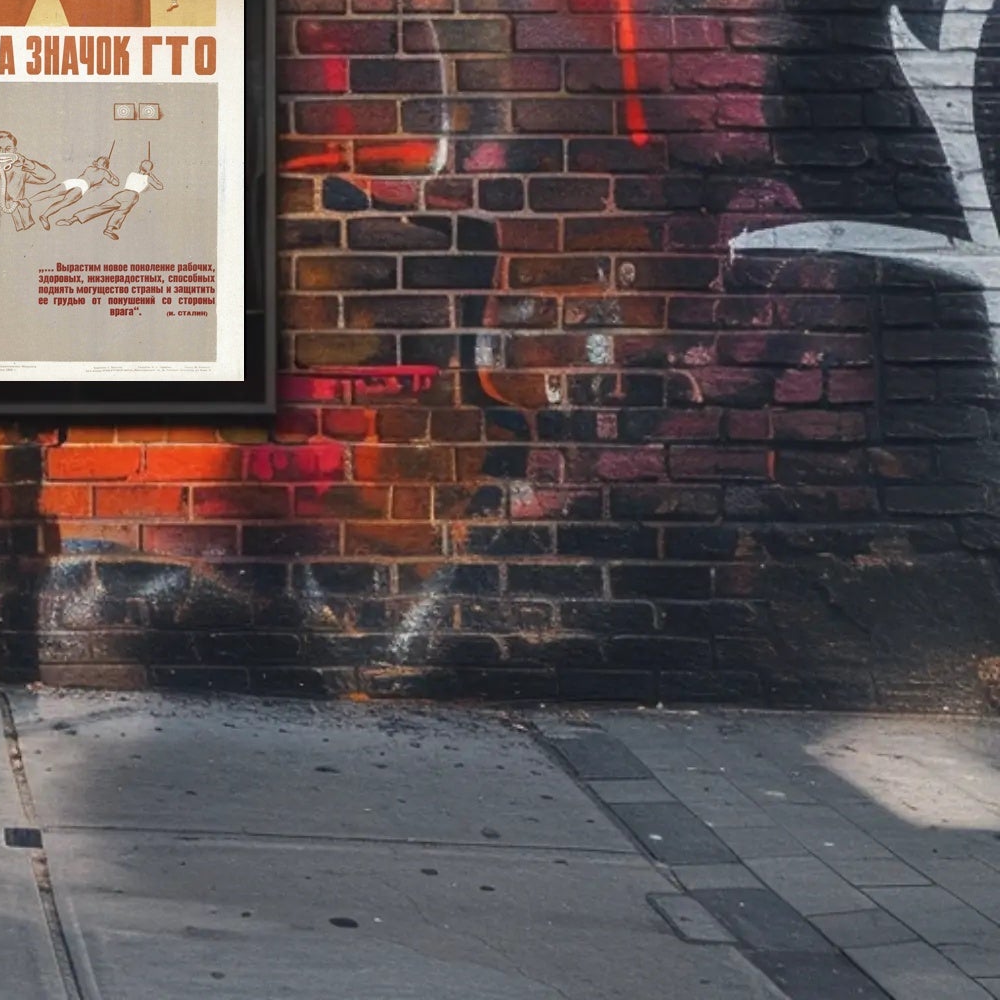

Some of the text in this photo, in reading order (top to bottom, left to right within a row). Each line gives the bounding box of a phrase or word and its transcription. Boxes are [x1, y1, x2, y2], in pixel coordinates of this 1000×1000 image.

[26, 35, 131, 75] ЗНАЧОК
[142, 36, 217, 75] ГТО
[56, 262, 101, 273] Вырастим
[103, 264, 128, 272] новое
[130, 264, 175, 272] поколение
[177, 262, 216, 273] рабочих,
[38, 273, 215, 284] здоровых, жизнерадостных, способных
[38, 286, 215, 295] поднять могущество страны и защитить
[38, 296, 215, 306] ее грудью от покушений со стороны
